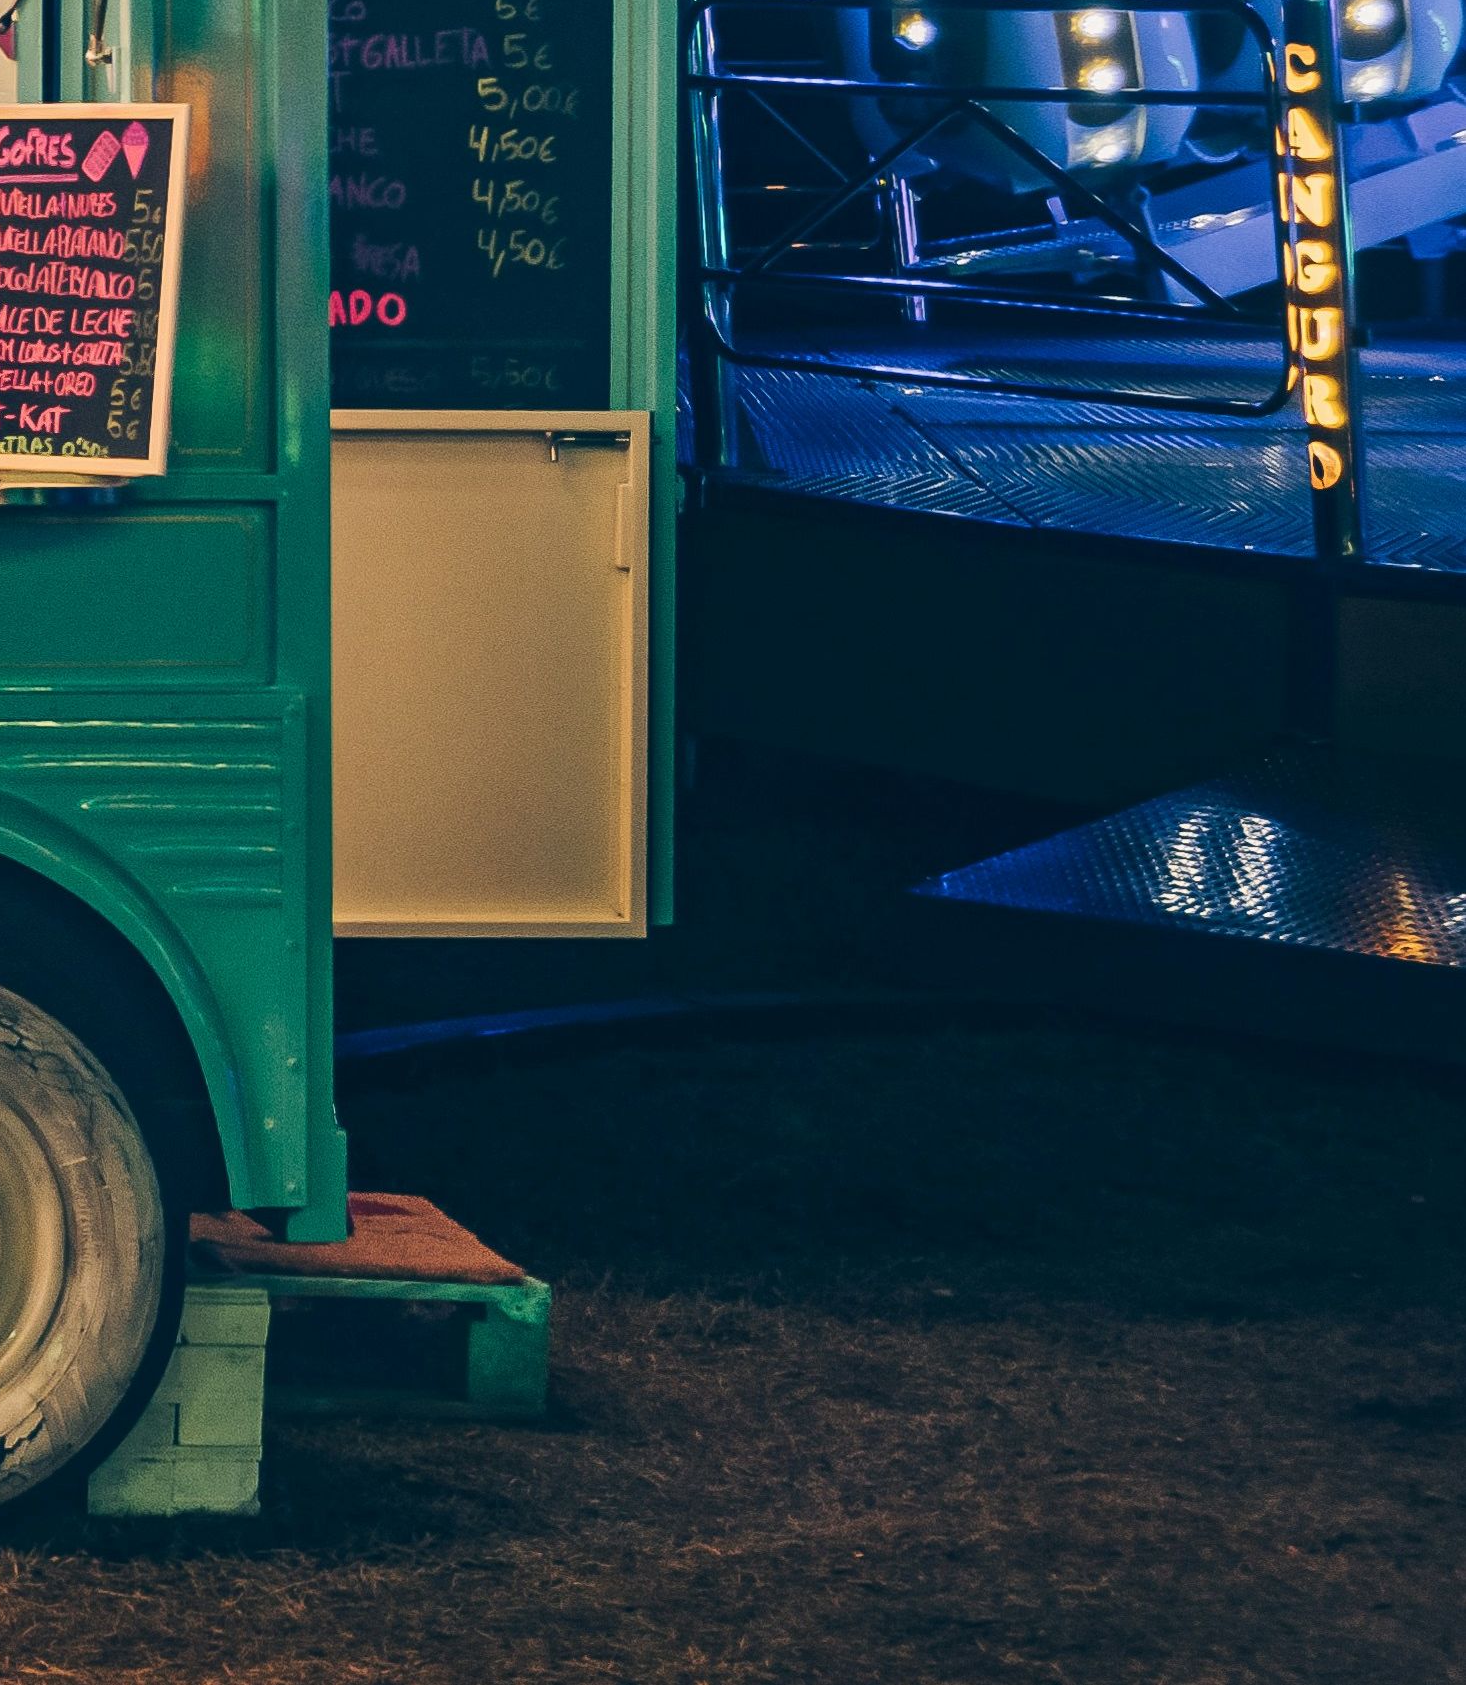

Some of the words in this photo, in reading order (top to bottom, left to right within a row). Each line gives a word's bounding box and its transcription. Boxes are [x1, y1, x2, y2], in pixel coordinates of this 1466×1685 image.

[502, 32, 556, 71] 5€
[476, 76, 581, 119] 5,00€
[468, 124, 557, 165] 4,50€
[472, 178, 560, 226] 4,50€
[477, 228, 569, 279] 4,50€
[1284, 42, 1348, 491] CANGURO
[34, 306, 66, 334] DE
[70, 306, 135, 338] LECHE
